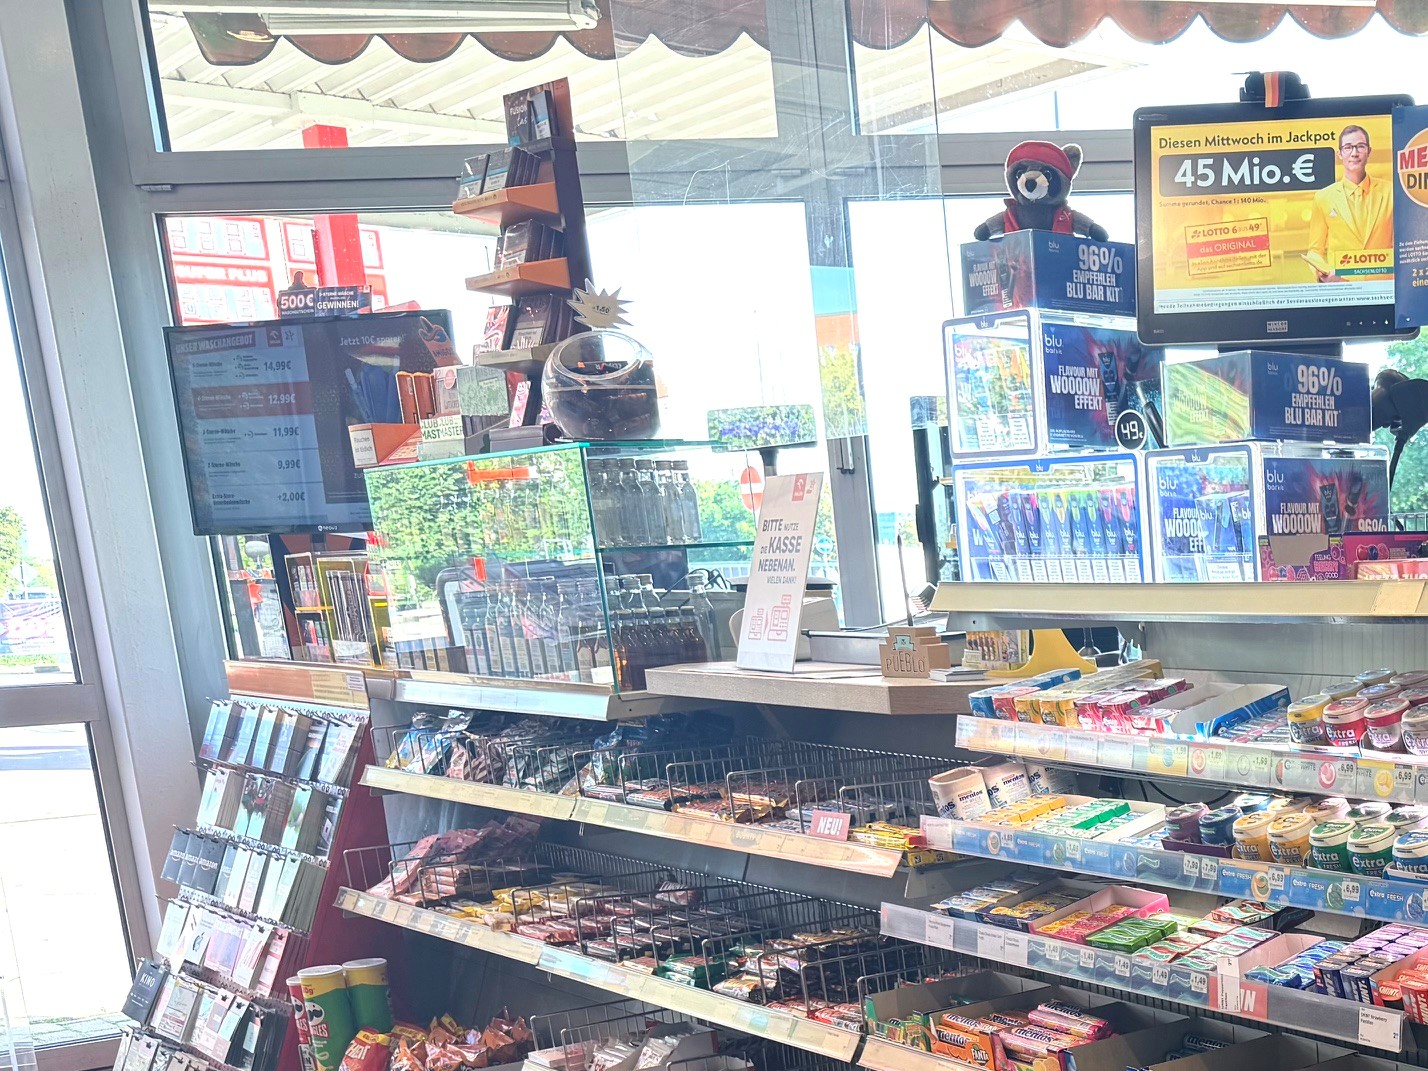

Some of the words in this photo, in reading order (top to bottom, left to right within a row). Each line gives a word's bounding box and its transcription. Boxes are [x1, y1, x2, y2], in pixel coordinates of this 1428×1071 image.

[1159, 137, 1201, 149] Diesen
[1204, 133, 1264, 148] Mittwoch
[1267, 132, 1282, 145] im
[1286, 130, 1336, 147] Jackpot
[1174, 158, 1215, 188] 45
[1214, 240, 1257, 253] ORIGINAL
[1079, 244, 1124, 274] 96%
[1073, 269, 1117, 287] EMPFEHLEN
[1412, 268, 1418, 277] 2
[1412, 278, 1428, 288] eine
[1066, 282, 1085, 299] BLU
[1086, 285, 1104, 301] BAR
[316, 300, 359, 311] GEWINNEN!
[263, 360, 293, 373] 14,99€
[1058, 365, 1085, 378] FLAVOUR
[1086, 367, 1099, 379] MIT
[1050, 374, 1101, 396] WOOOOW
[1075, 395, 1103, 411] EFFEKT
[272, 427, 300, 438] 11,99€
[277, 459, 301, 470] 9,99€
[1266, 470, 1286, 484] blu
[762, 518, 784, 532] BITTE
[768, 536, 803, 554] KASSE
[758, 558, 796, 572] NEBENAN.
[885, 651, 926, 674] PUEBLO
[816, 816, 843, 836] NEU!
[1353, 855, 1386, 869] extra
